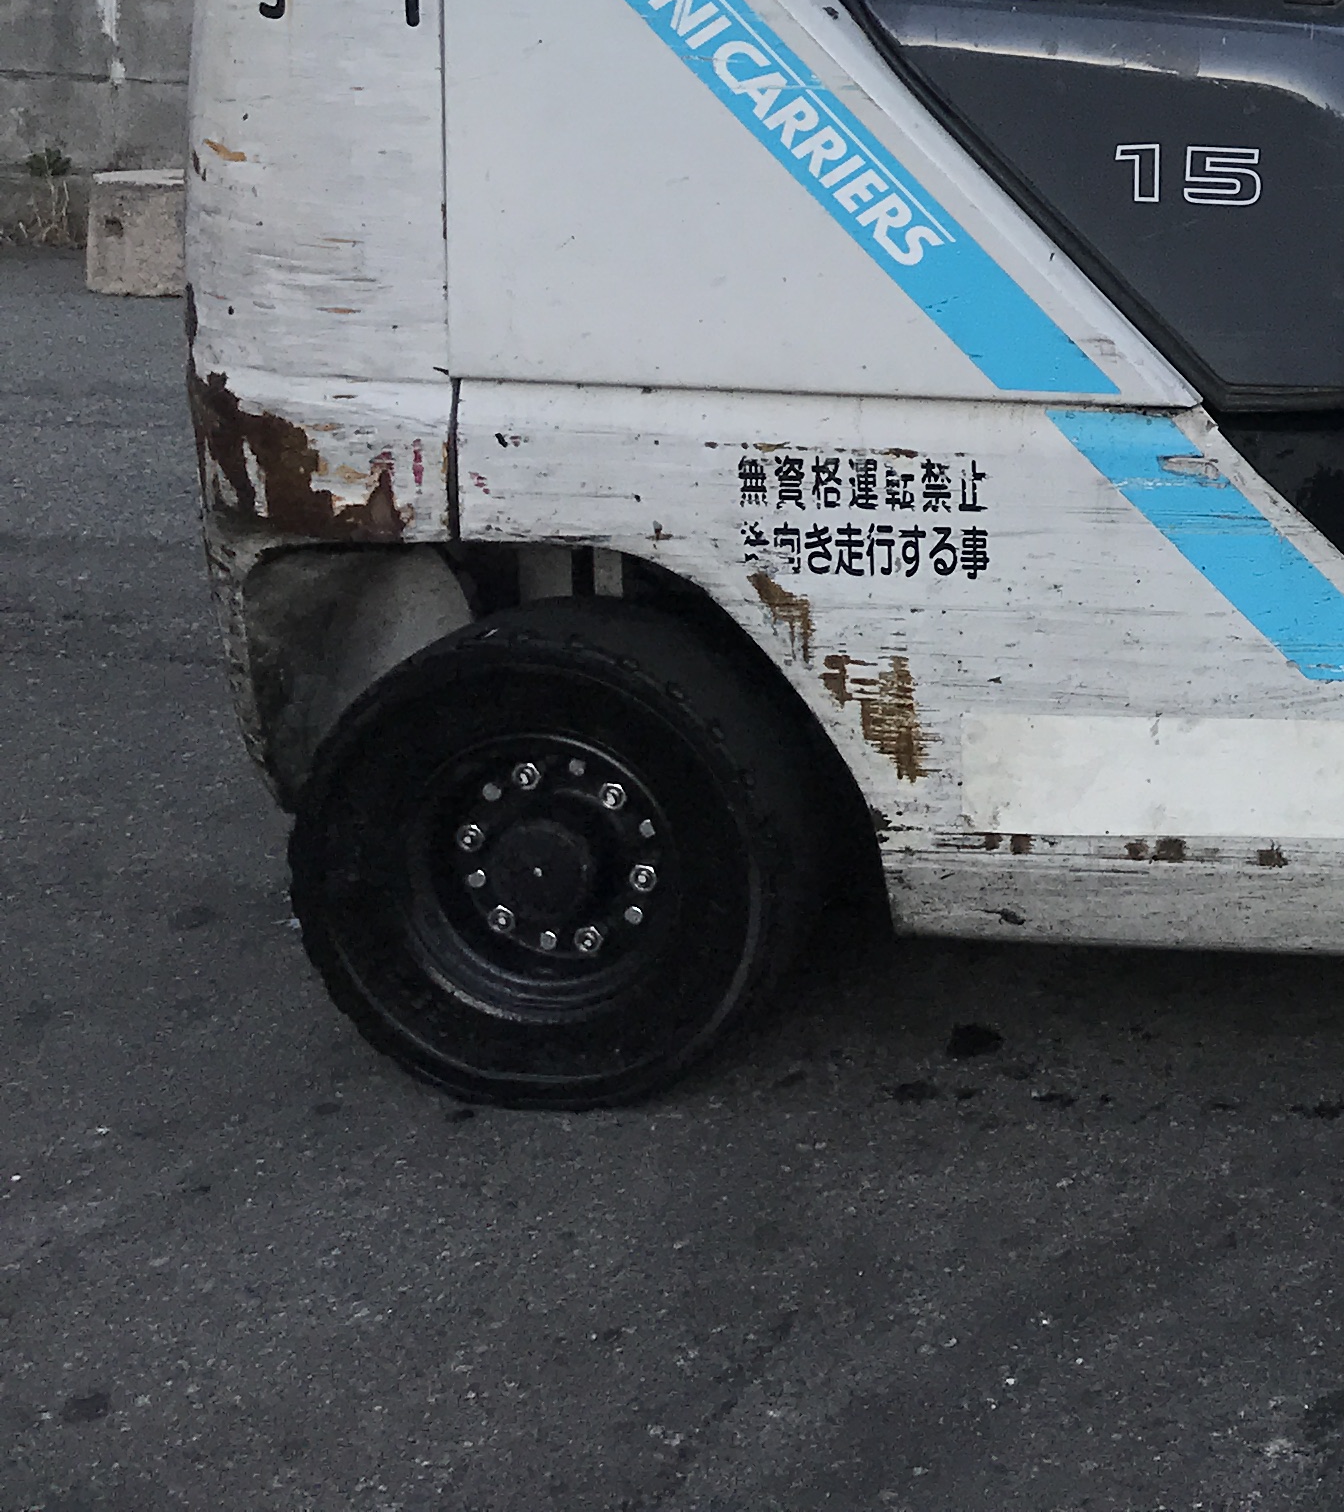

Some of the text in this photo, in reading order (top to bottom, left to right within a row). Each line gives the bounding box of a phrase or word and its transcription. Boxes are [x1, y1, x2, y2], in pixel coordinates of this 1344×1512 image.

[1115, 143, 1262, 207] 15
[738, 455, 992, 513] 無資格運転禁止
